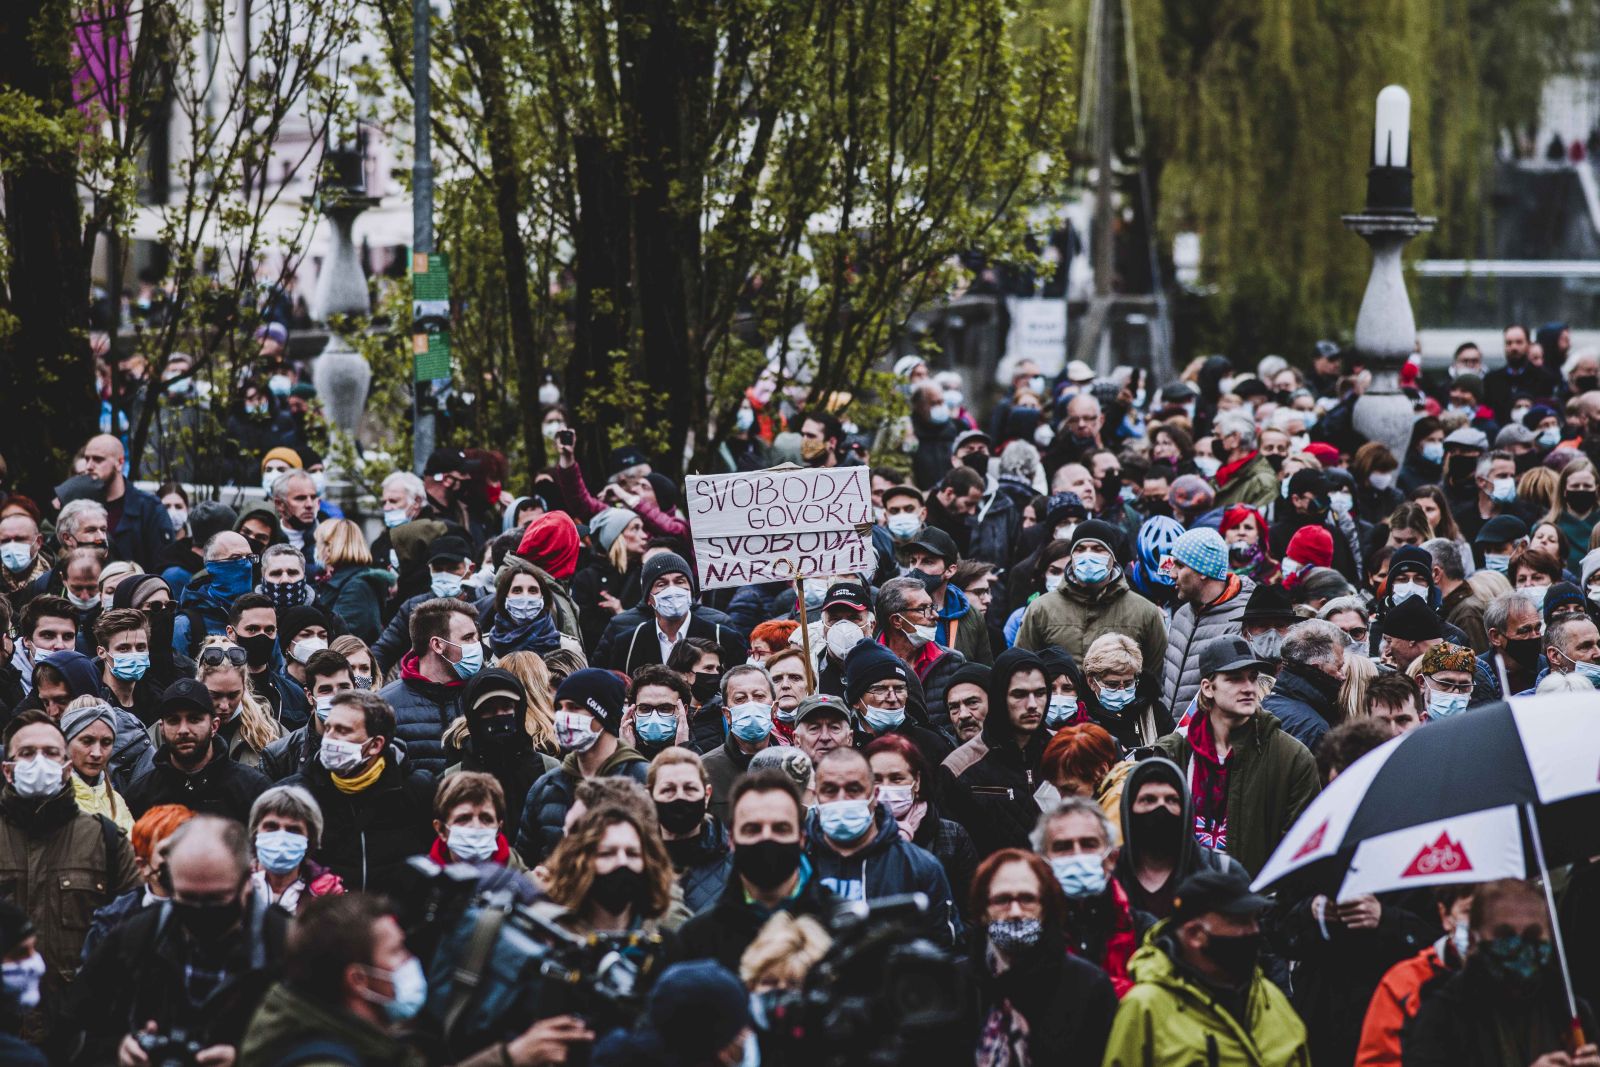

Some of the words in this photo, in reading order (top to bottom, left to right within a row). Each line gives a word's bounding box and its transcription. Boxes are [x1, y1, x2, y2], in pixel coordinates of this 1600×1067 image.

[696, 471, 864, 514] SVOBODA
[748, 502, 869, 530] GOVORU
[708, 530, 866, 559] SVOBODA
